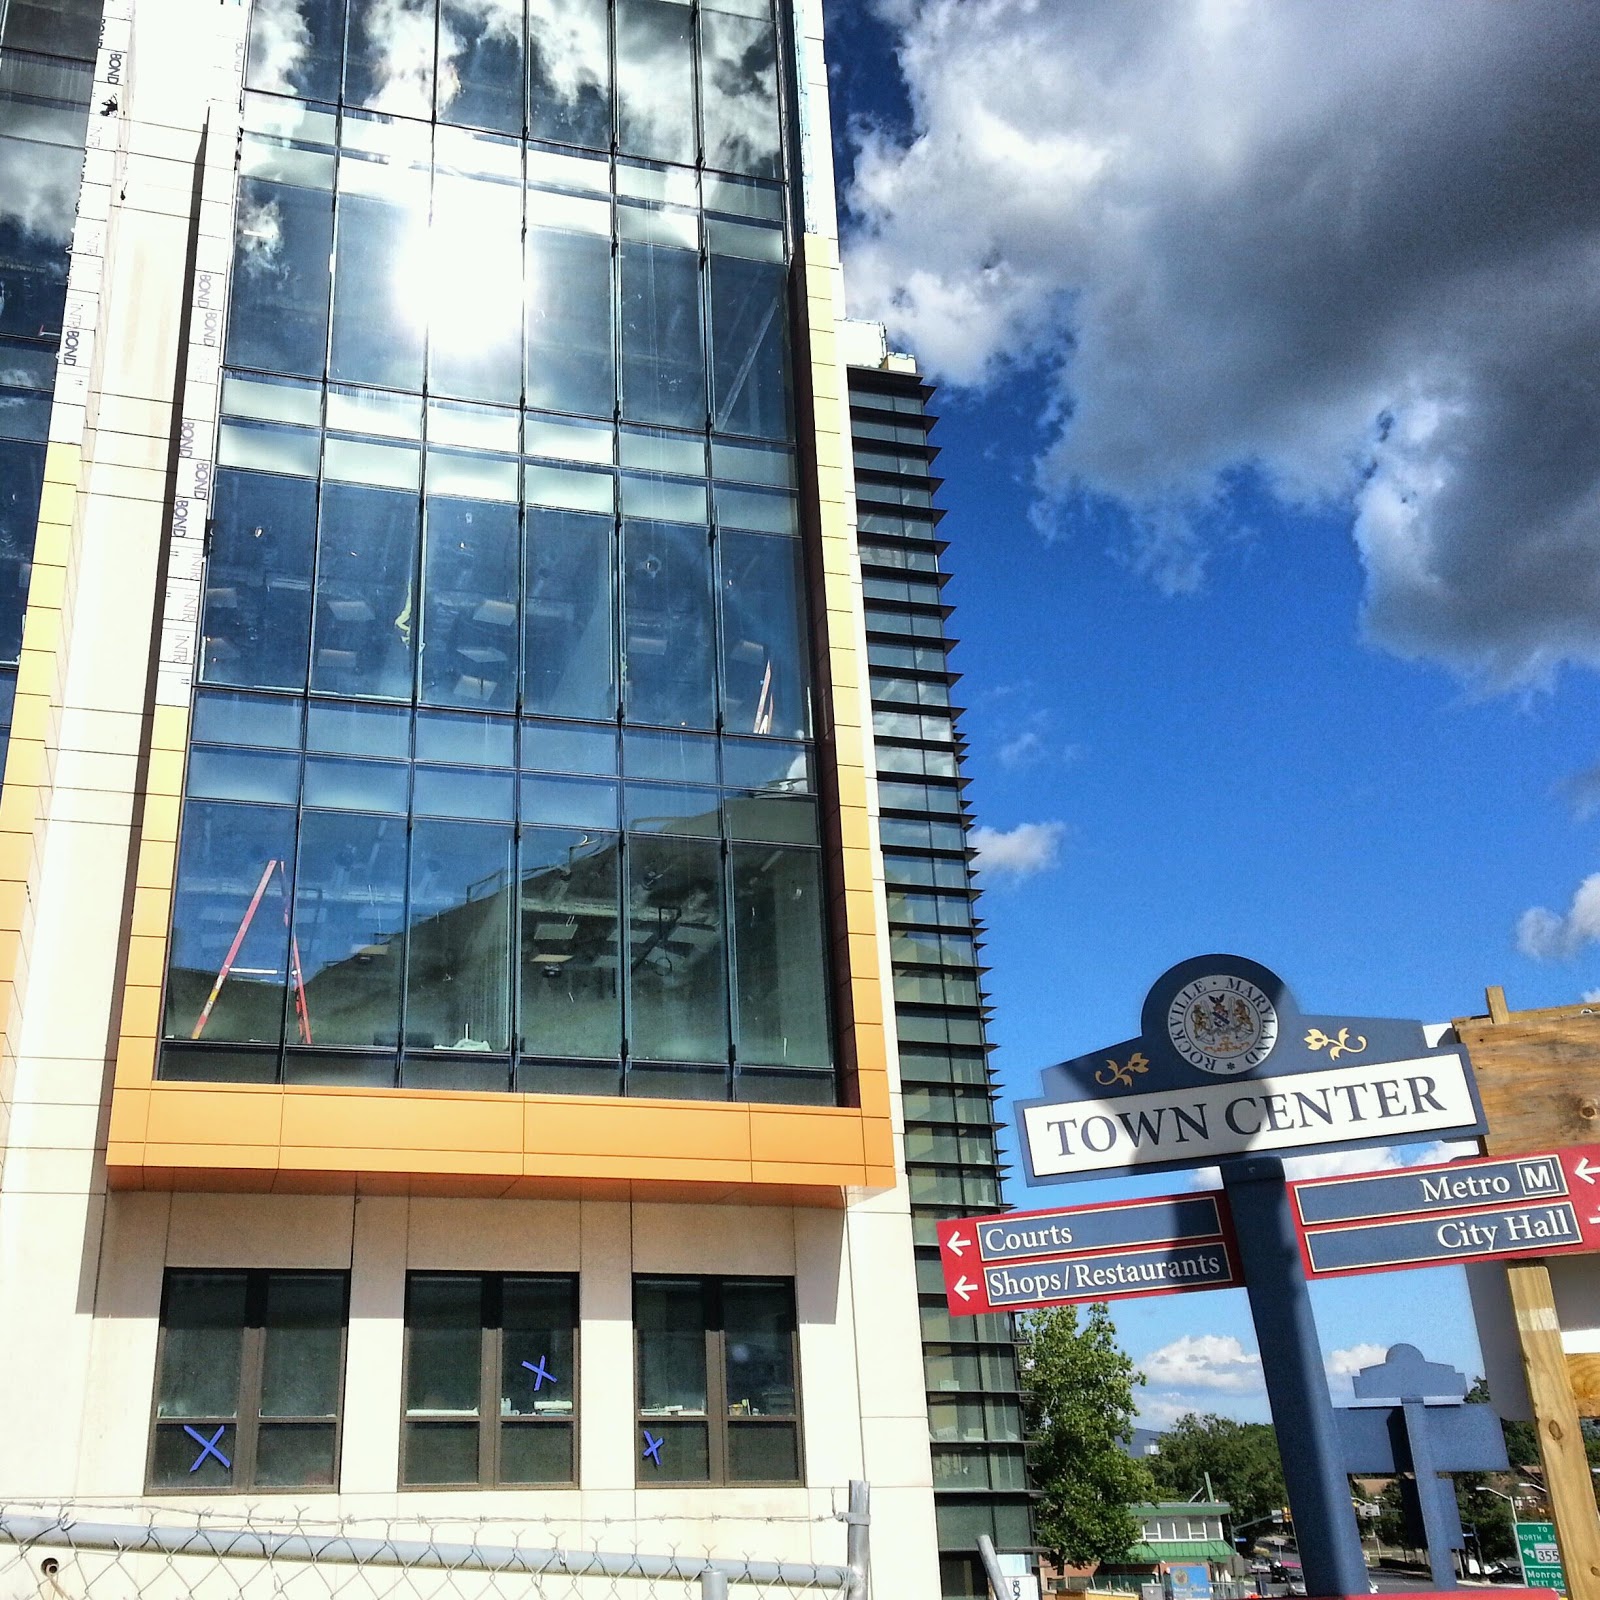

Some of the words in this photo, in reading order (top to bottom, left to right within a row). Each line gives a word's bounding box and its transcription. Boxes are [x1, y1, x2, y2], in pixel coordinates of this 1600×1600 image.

[107, 53, 122, 85] BOND
[198, 274, 212, 309] BOND
[204, 312, 218, 347] BOND
[63, 330, 80, 367] BOND
[179, 421, 195, 458] BOND
[194, 462, 209, 499] BOND
[173, 500, 189, 538] BOND
[1168, 980, 1217, 1071] ROCKVILLE
[1225, 977, 1276, 1065] MARYLAND
[1046, 1103, 1210, 1157] TOWN
[1224, 1075, 1447, 1136] CENTER
[1419, 1175, 1511, 1203] Metro
[1523, 1165, 1552, 1189] M
[985, 1224, 1073, 1252] Courts
[1437, 1220, 1499, 1251] City
[1503, 1208, 1573, 1242] Hall
[989, 1254, 1221, 1299] Shops/Restaurants
[1526, 1569, 1562, 1579] Monroe
[1538, 1550, 1560, 1562] 355
